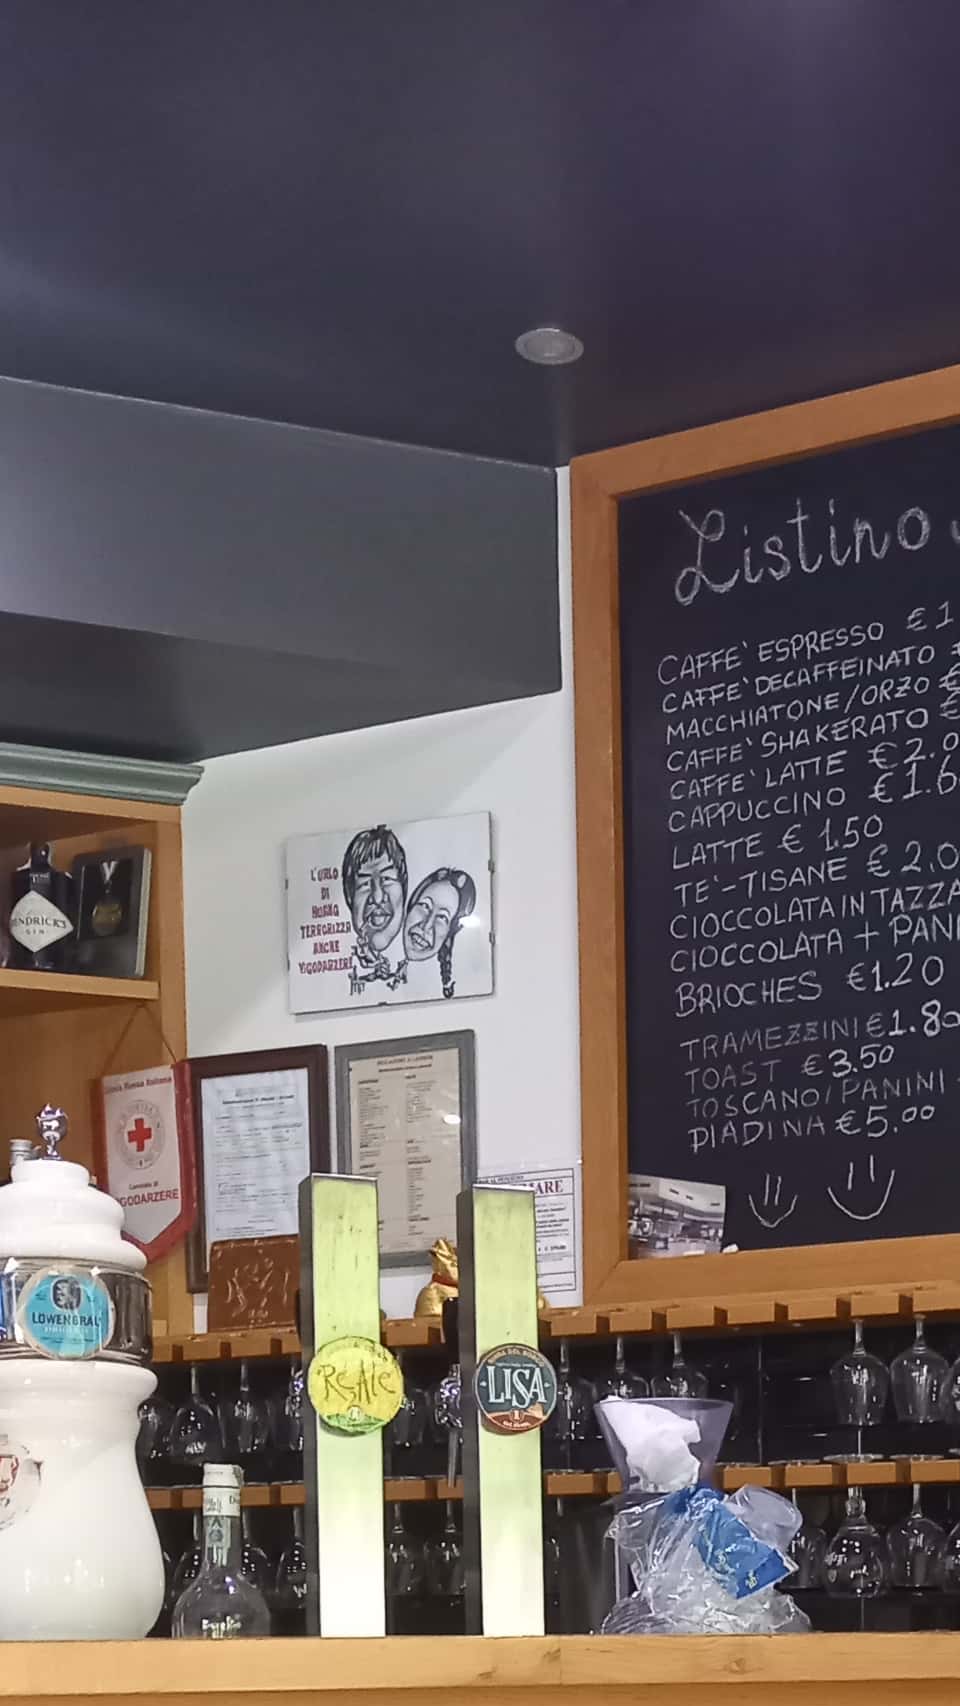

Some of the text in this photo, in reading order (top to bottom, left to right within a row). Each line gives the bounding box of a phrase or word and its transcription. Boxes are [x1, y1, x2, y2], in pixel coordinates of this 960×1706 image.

[674, 499, 932, 606] Listino
[759, 622, 884, 662] ESPRESSO
[755, 645, 935, 695] DECAFFEINATO
[761, 708, 929, 757] SHAKERATO
[765, 750, 847, 788] LATTE
[668, 787, 846, 832] CAPPUCCINO
[673, 832, 764, 870] LATTE
[671, 928, 843, 972] CIOCCOLATA
[675, 970, 822, 1017] BRIOCHES
[680, 1018, 858, 1060] TRAMEZZINI
[686, 1059, 782, 1094] TOAST
[687, 1116, 826, 1153] PIADINA
[117, 1188, 179, 1207] GODARZERE
[486, 1365, 547, 1408] LISA
